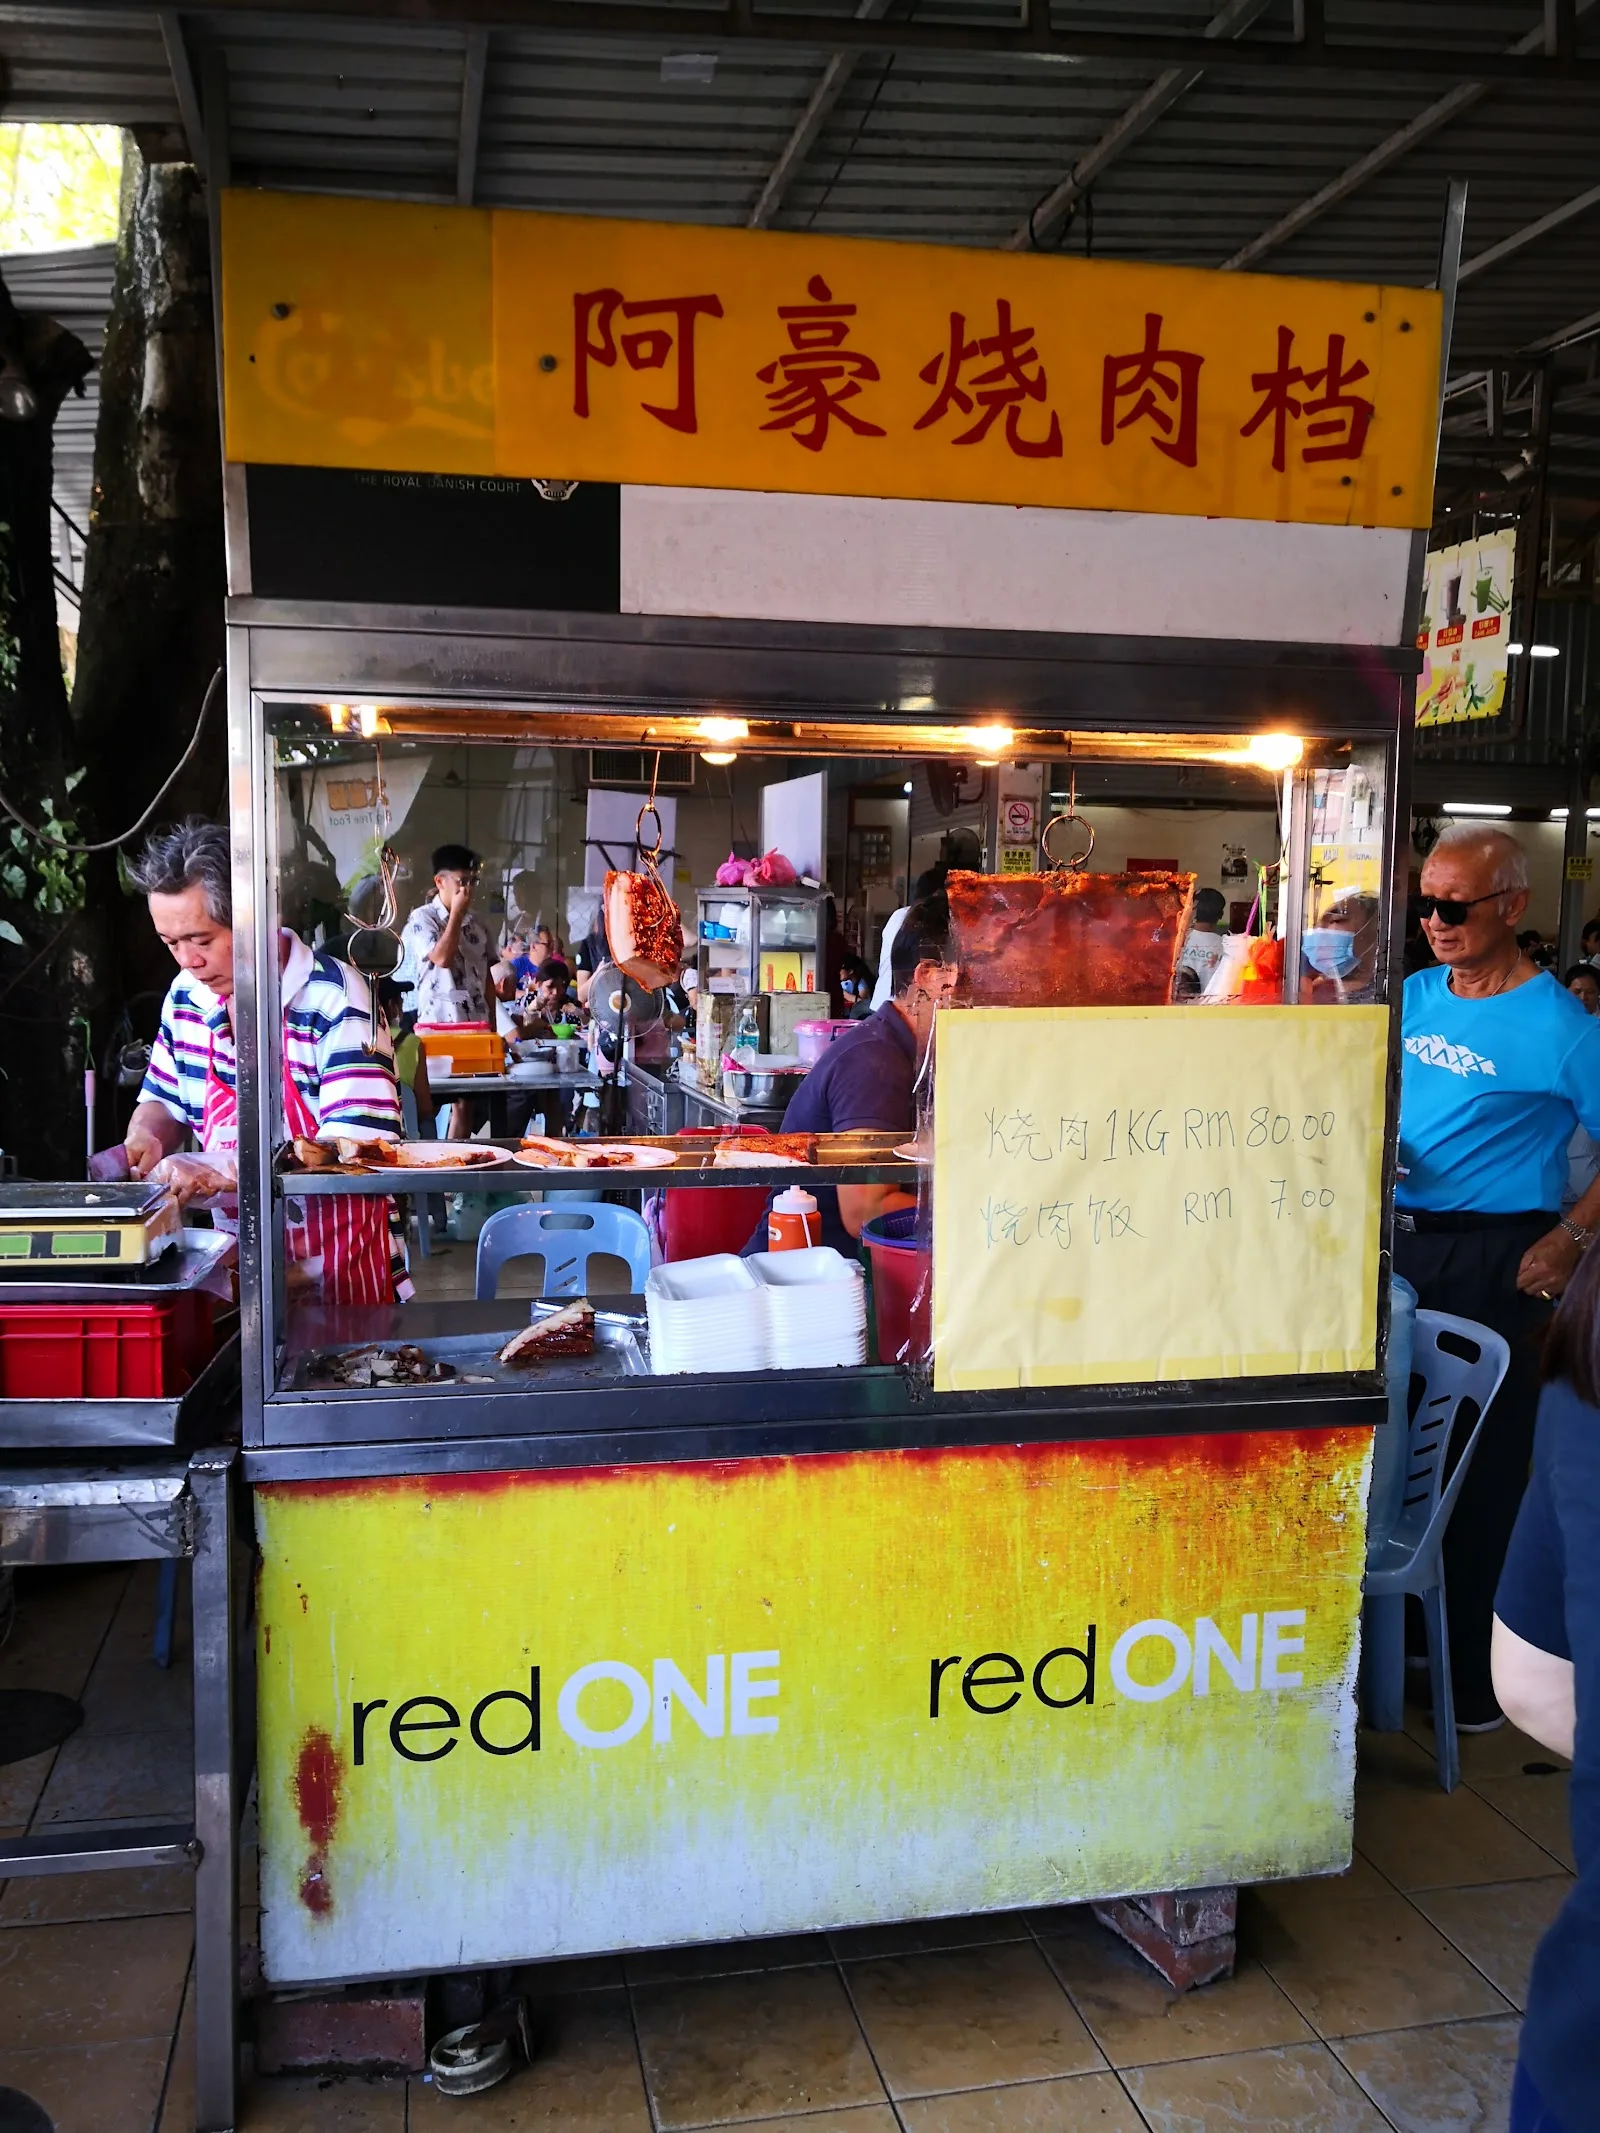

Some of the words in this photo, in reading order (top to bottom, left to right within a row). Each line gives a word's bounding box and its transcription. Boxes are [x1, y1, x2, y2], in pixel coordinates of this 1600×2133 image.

[573, 274, 1375, 472] 阿豪烧肉档
[383, 475, 422, 488] ROYAL
[428, 477, 475, 490] DANISH
[479, 480, 521, 493] COURT
[984, 1106, 1088, 1162] 烧肉
[1184, 1108, 1236, 1150] RM
[1246, 1105, 1335, 1148] 80.00
[1184, 1187, 1232, 1226] RM
[1269, 1178, 1335, 1220] 7.00
